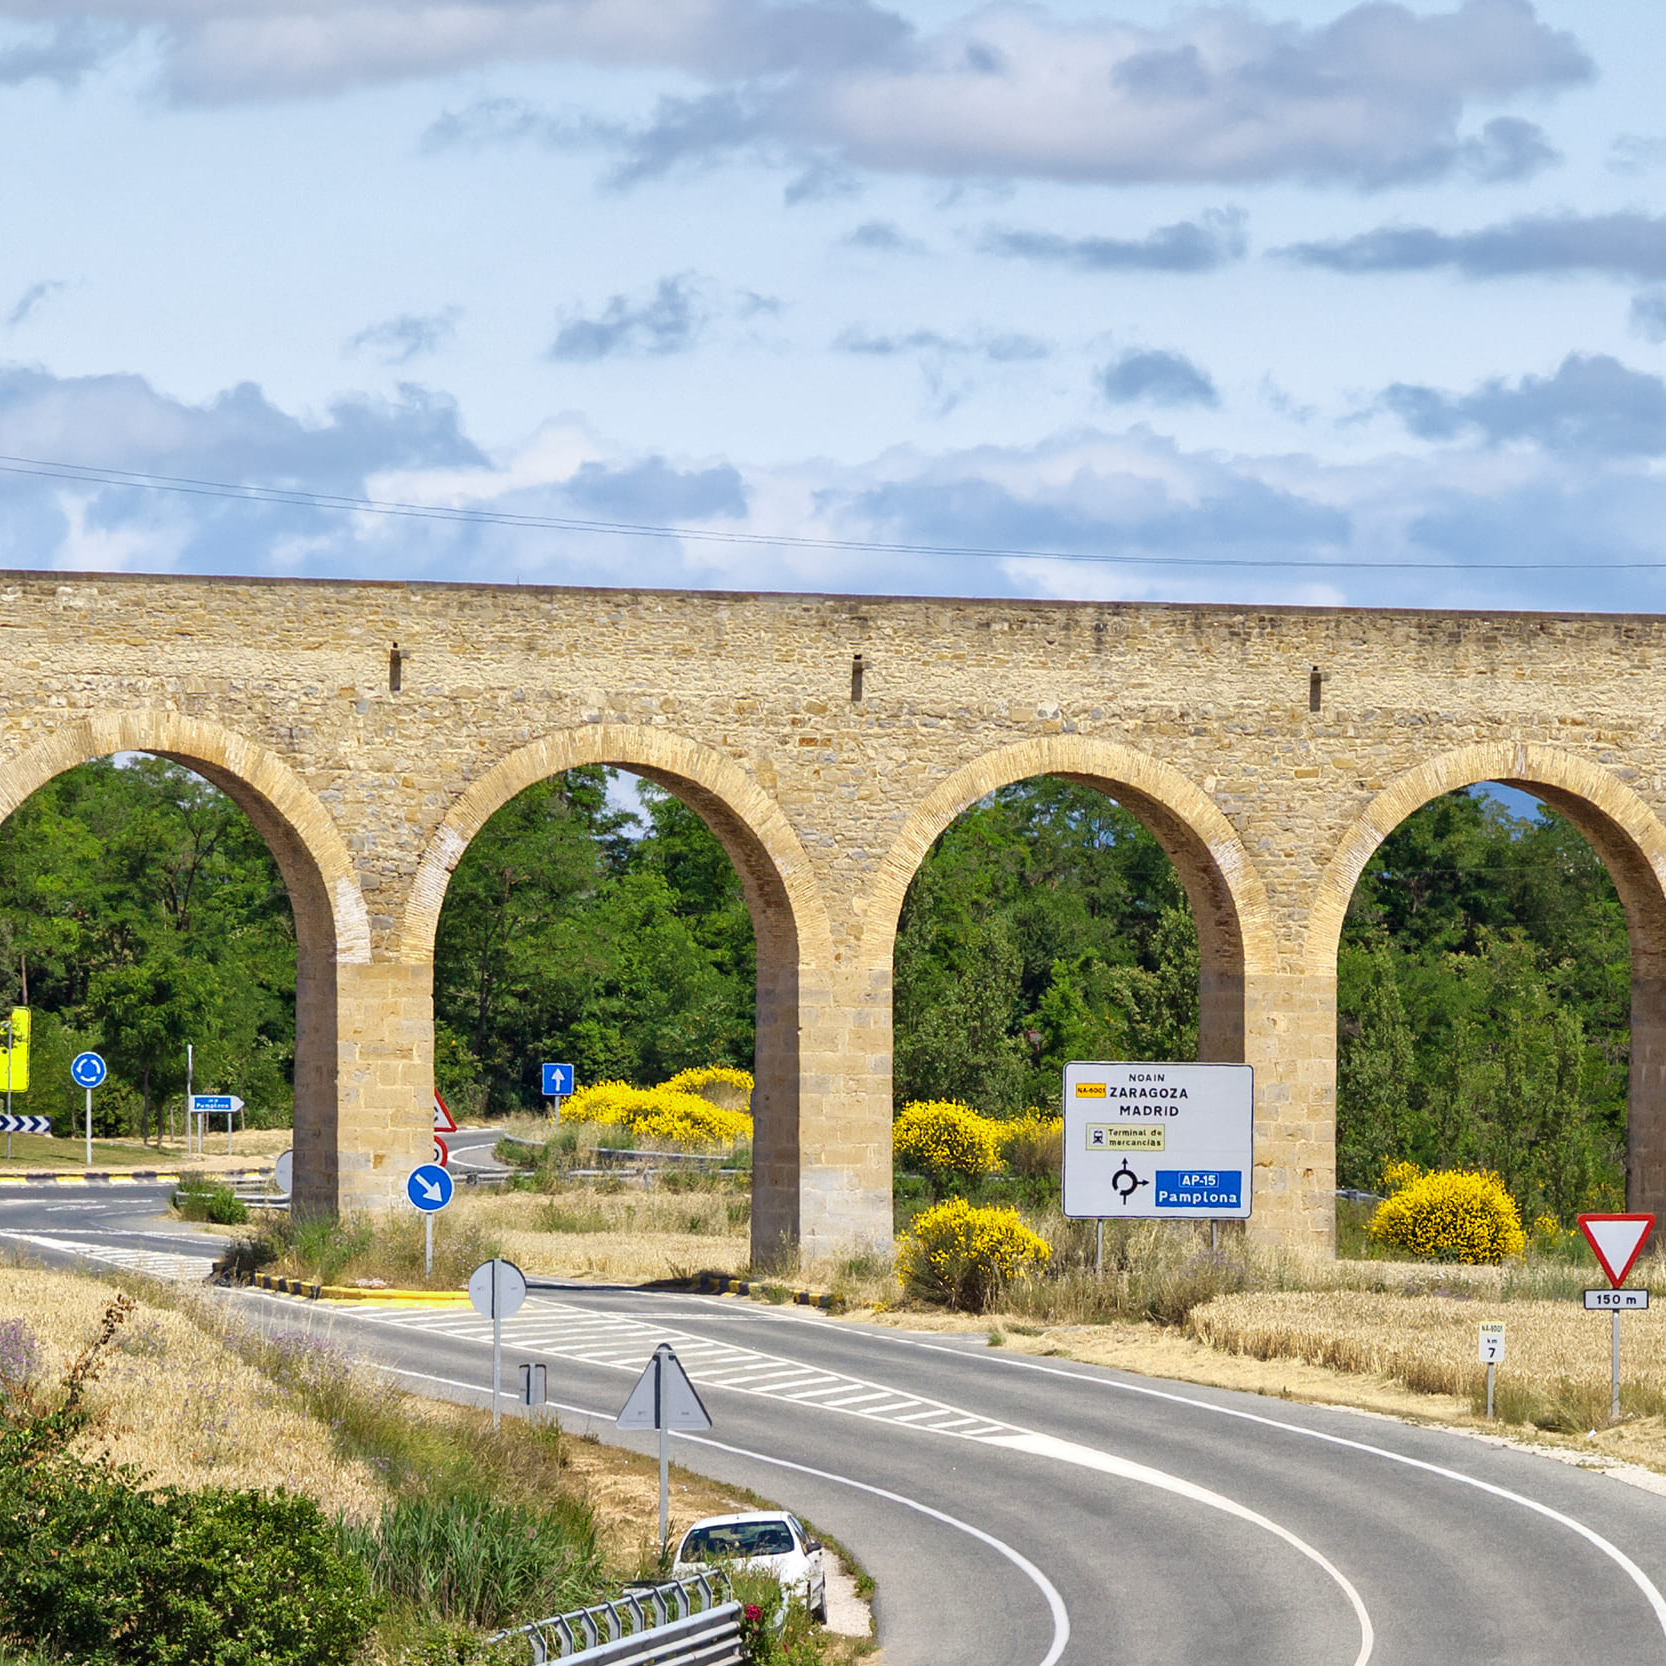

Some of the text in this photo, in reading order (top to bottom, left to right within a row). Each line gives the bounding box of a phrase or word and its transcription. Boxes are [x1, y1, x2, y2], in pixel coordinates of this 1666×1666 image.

[1110, 1087, 1188, 1099] ZARAGOZA
[1119, 1105, 1179, 1116] MADRID
[1182, 1175, 1216, 1186] AP-15
[1159, 1191, 1237, 1204] Pamplona
[1597, 1294, 1621, 1305] 150
[1488, 1347, 1496, 1358] 7
